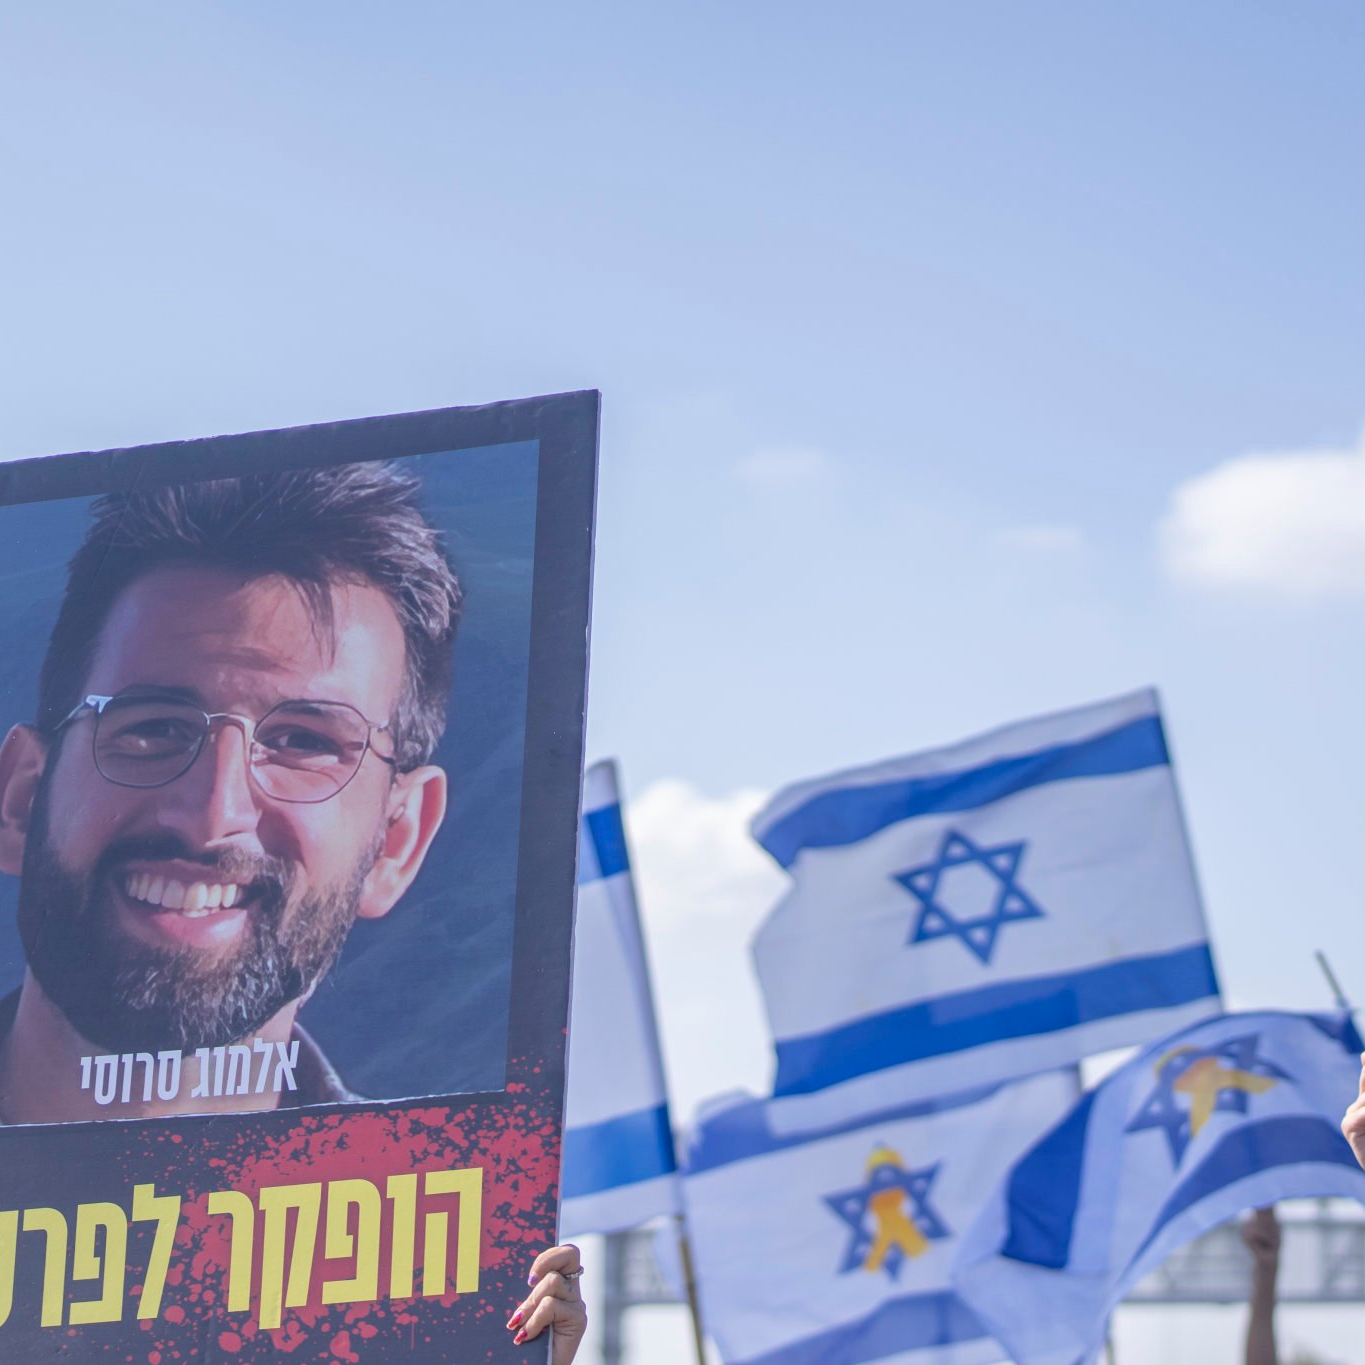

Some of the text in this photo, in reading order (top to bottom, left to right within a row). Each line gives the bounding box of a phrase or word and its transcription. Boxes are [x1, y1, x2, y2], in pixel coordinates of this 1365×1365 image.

[79, 1039, 301, 1106] אלמוג סרוסי
[208, 1167, 484, 1330] הופקר
